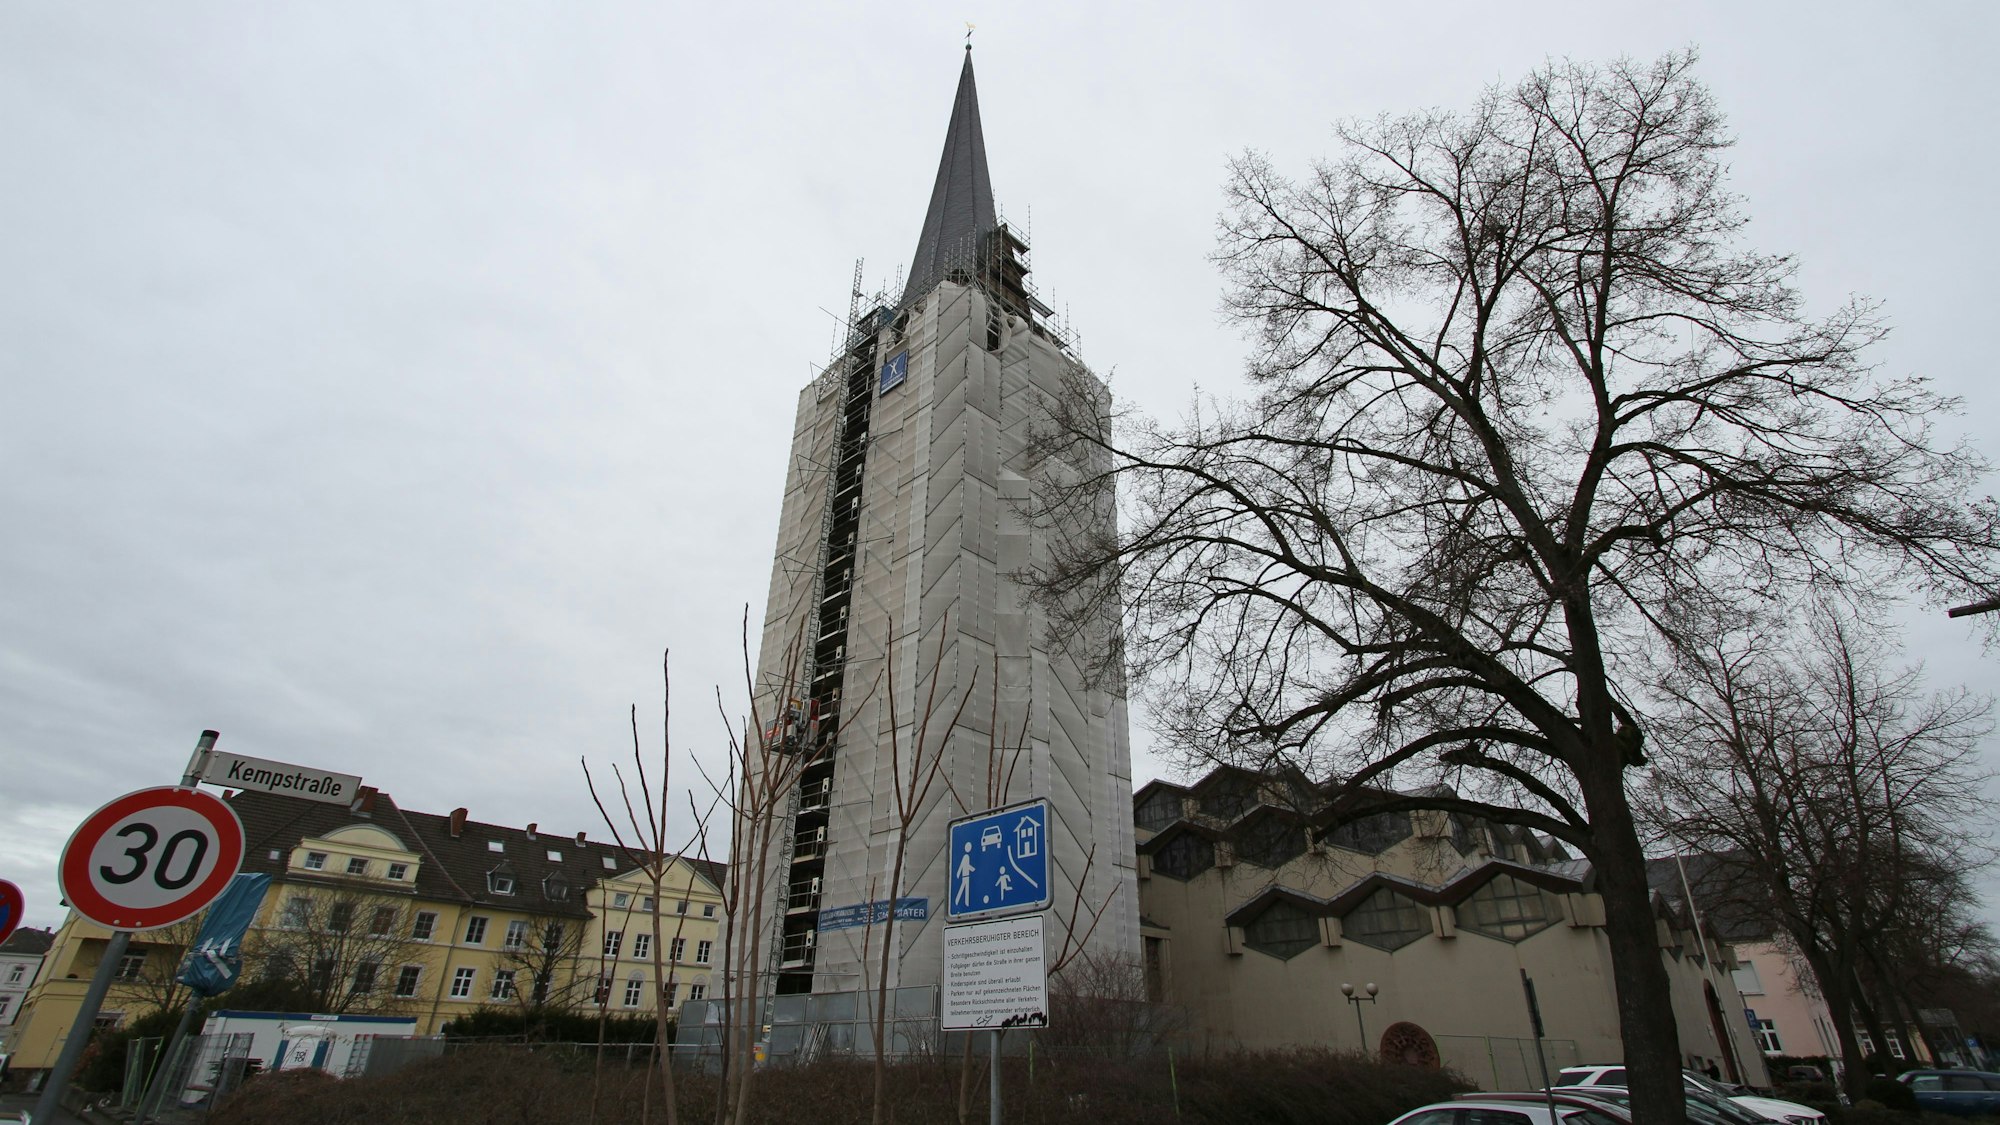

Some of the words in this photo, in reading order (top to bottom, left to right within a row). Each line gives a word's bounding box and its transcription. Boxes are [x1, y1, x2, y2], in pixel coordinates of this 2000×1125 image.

[228, 760, 342, 796] Kempstraße
[100, 822, 209, 890] 30
[948, 932, 1011, 946] VERKEHRSBERUHIGTER
[1014, 929, 1039, 939] BEREICH
[951, 949, 998, 959] Schrittgeschwindigkeit
[983, 987, 1022, 995] gekennzeichneten
